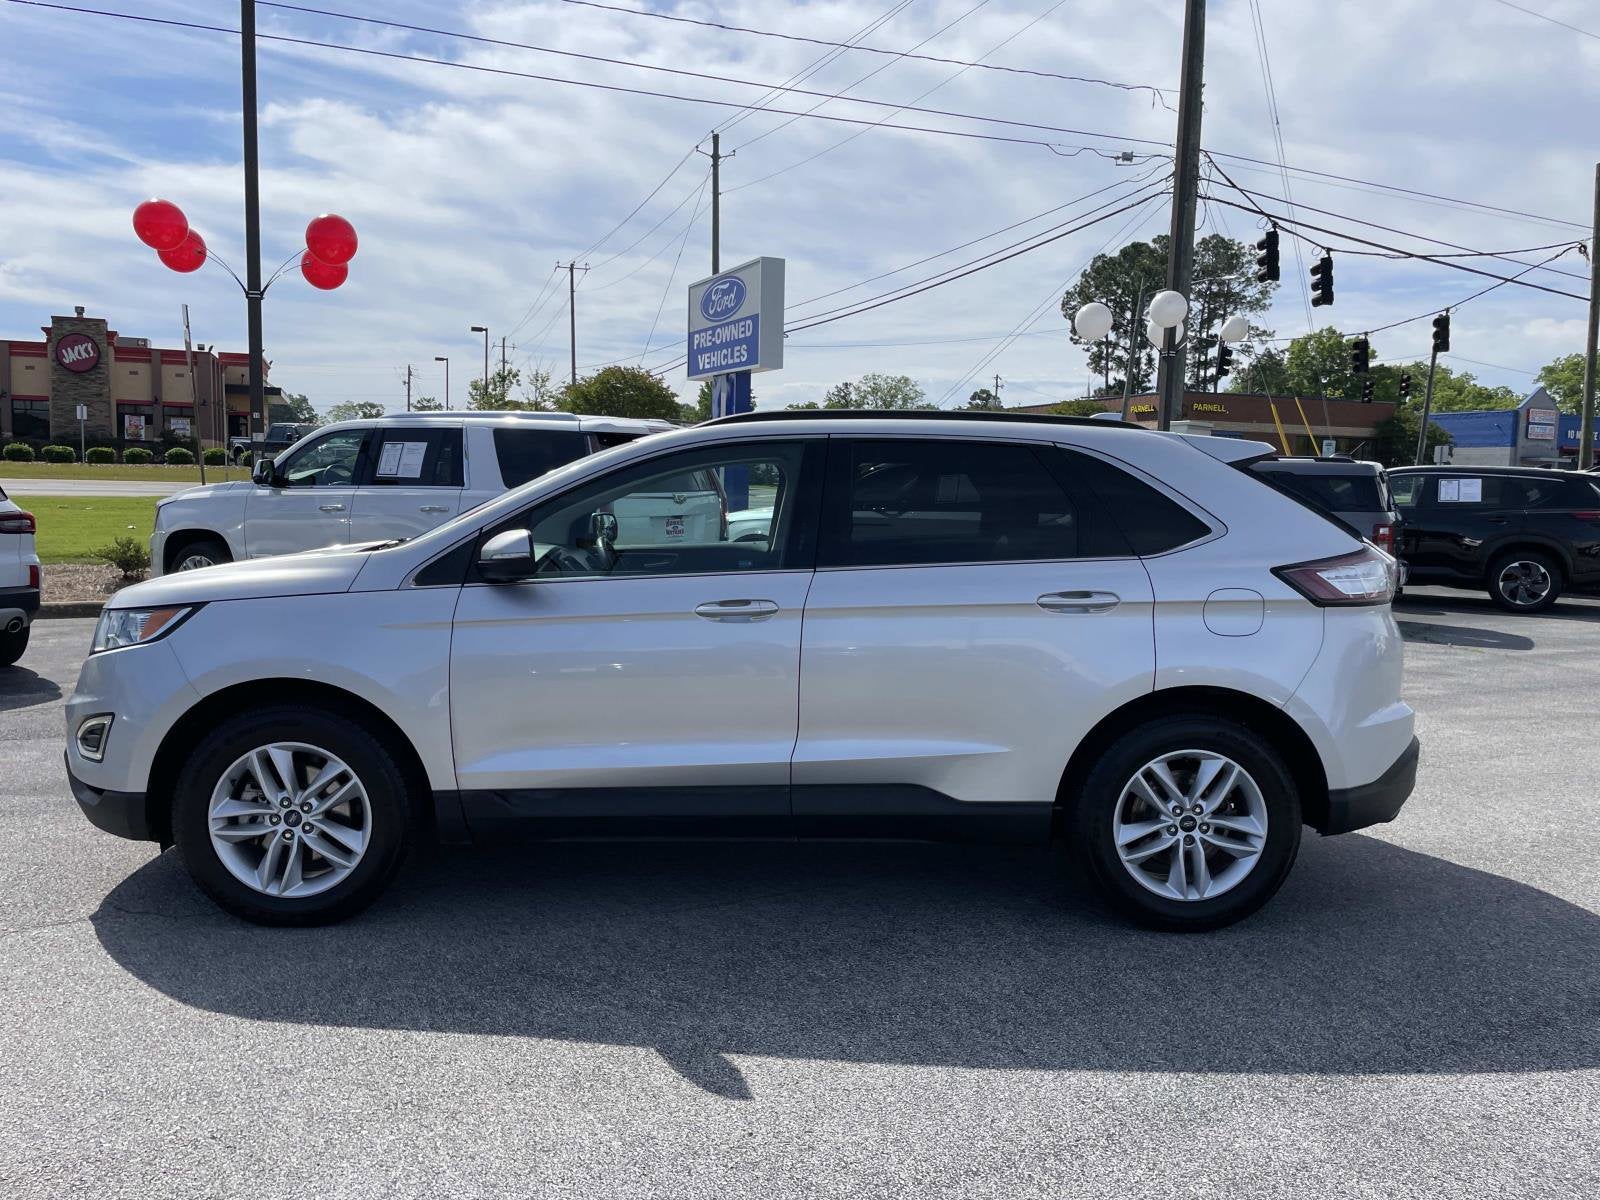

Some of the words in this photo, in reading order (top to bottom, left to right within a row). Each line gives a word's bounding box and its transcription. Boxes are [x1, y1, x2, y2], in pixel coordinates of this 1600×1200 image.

[708, 281, 737, 315] Ford
[693, 319, 753, 350] PRE-OWNED
[62, 342, 94, 364] JACK'S
[697, 344, 748, 370] VEHICLES
[1130, 404, 1154, 414] PARNELL
